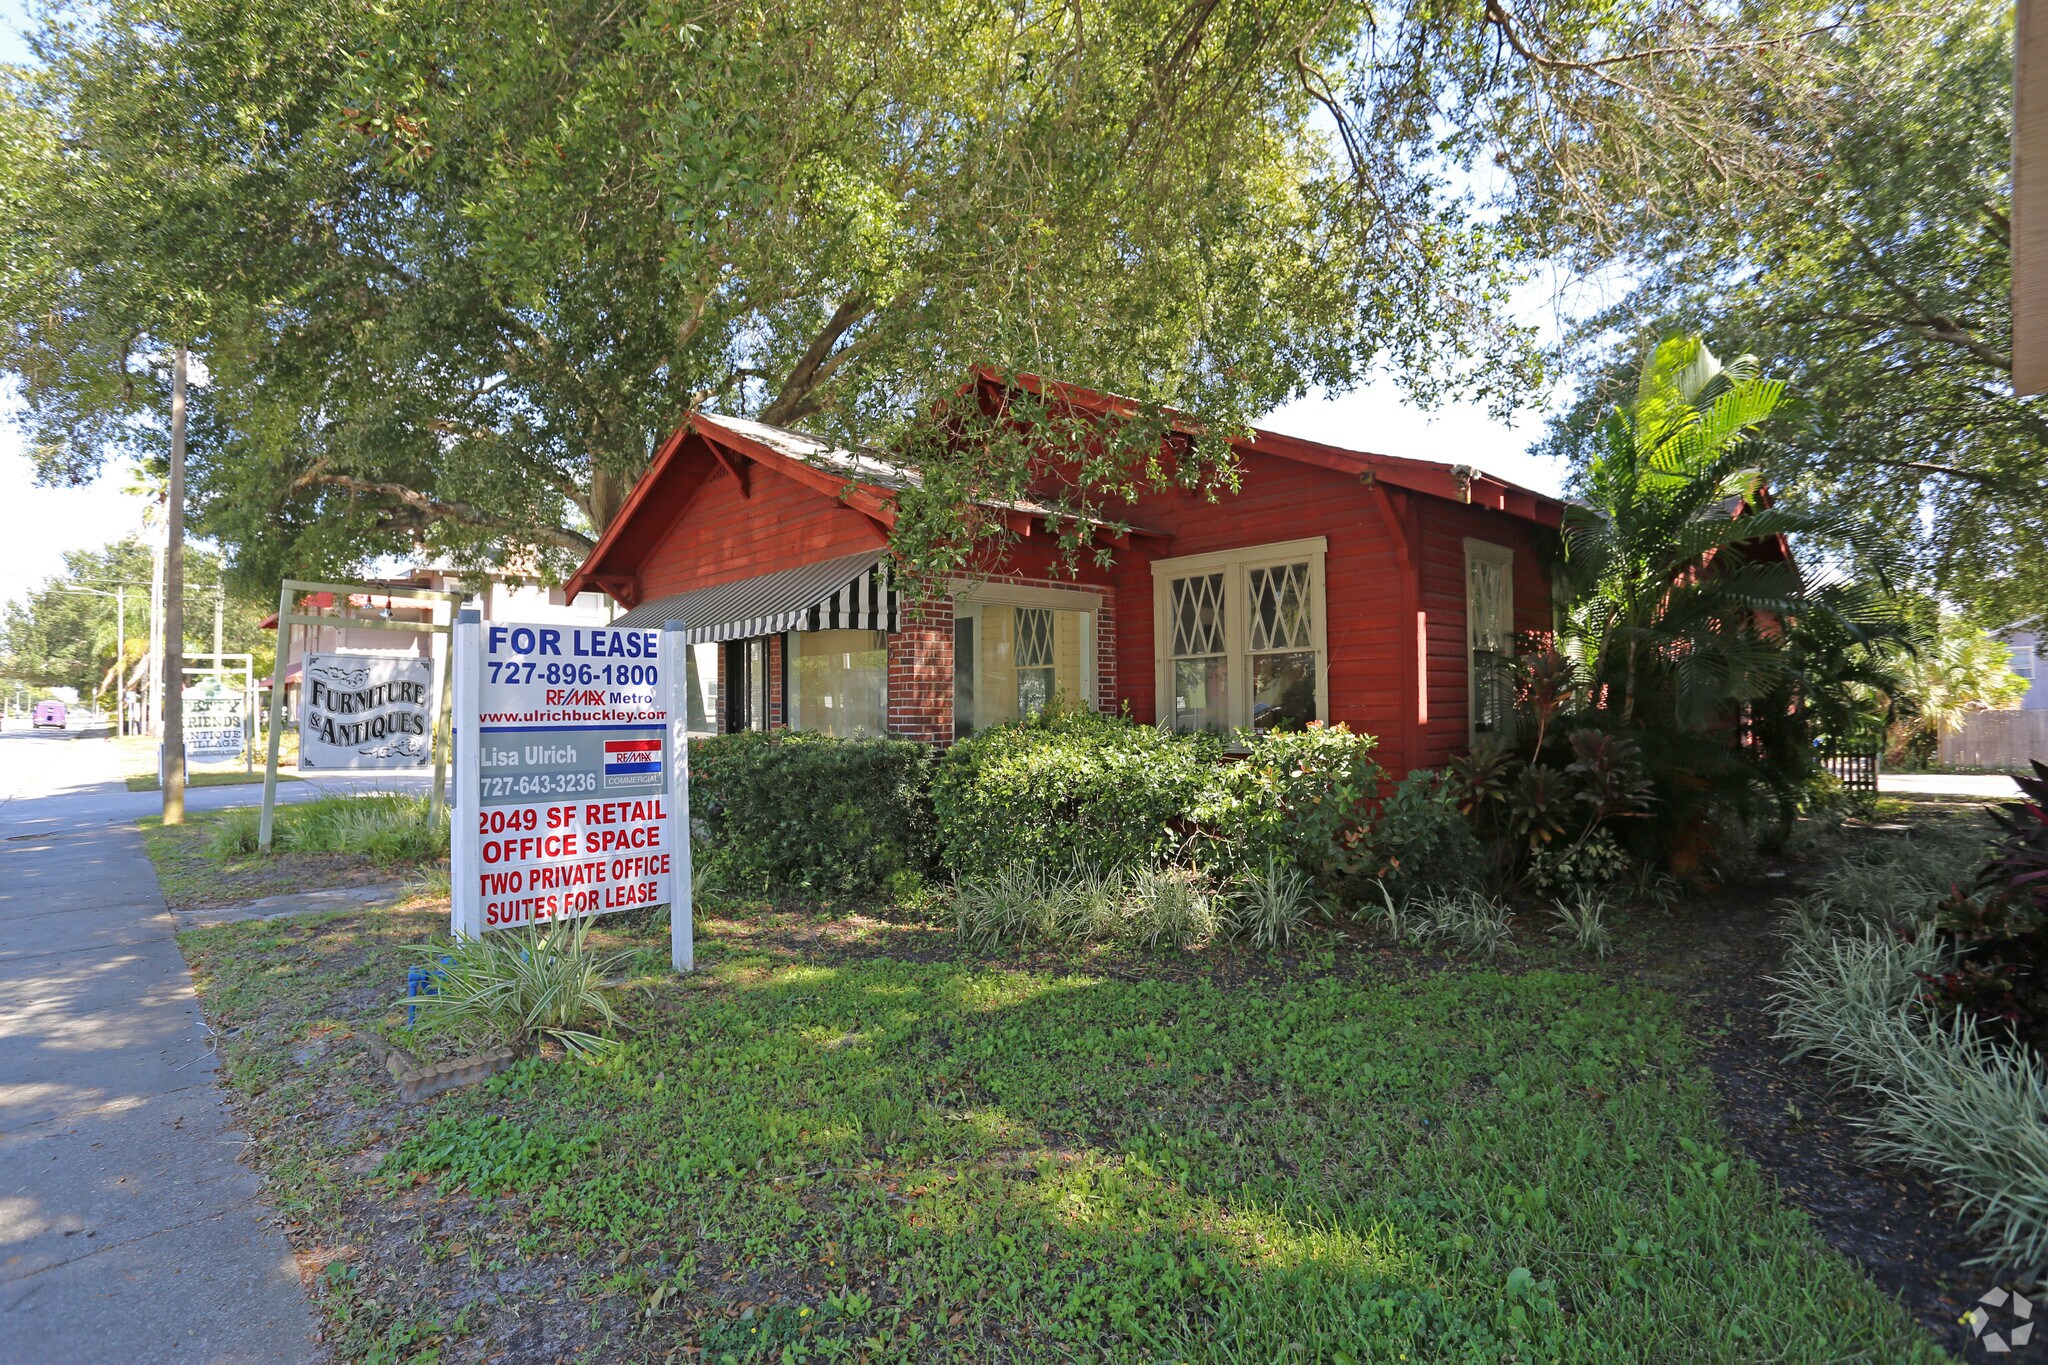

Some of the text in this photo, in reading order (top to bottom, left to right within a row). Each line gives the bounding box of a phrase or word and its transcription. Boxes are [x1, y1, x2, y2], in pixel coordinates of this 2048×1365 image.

[489, 627, 658, 658] FOR LEASE
[488, 662, 658, 685] 727-896-1800
[310, 679, 425, 714] FURNITURE
[546, 688, 653, 706] RE/MAX Metro
[184, 716, 241, 728] RIENDS
[318, 711, 424, 747] ANTIQUES
[186, 731, 241, 739] NTIQUE
[481, 745, 577, 766] Lisa Ulrich
[616, 752, 652, 763] RE/MAX
[481, 773, 596, 797] 727-643-3236
[608, 775, 658, 785] COMMERCIAL
[480, 800, 666, 834] 2049 SF RETAIL
[482, 826, 660, 863] OFFICE SPACE
[480, 854, 669, 896] TWO PRIVATE OFFICE
[486, 881, 657, 925] SUITES FOR LEASE
